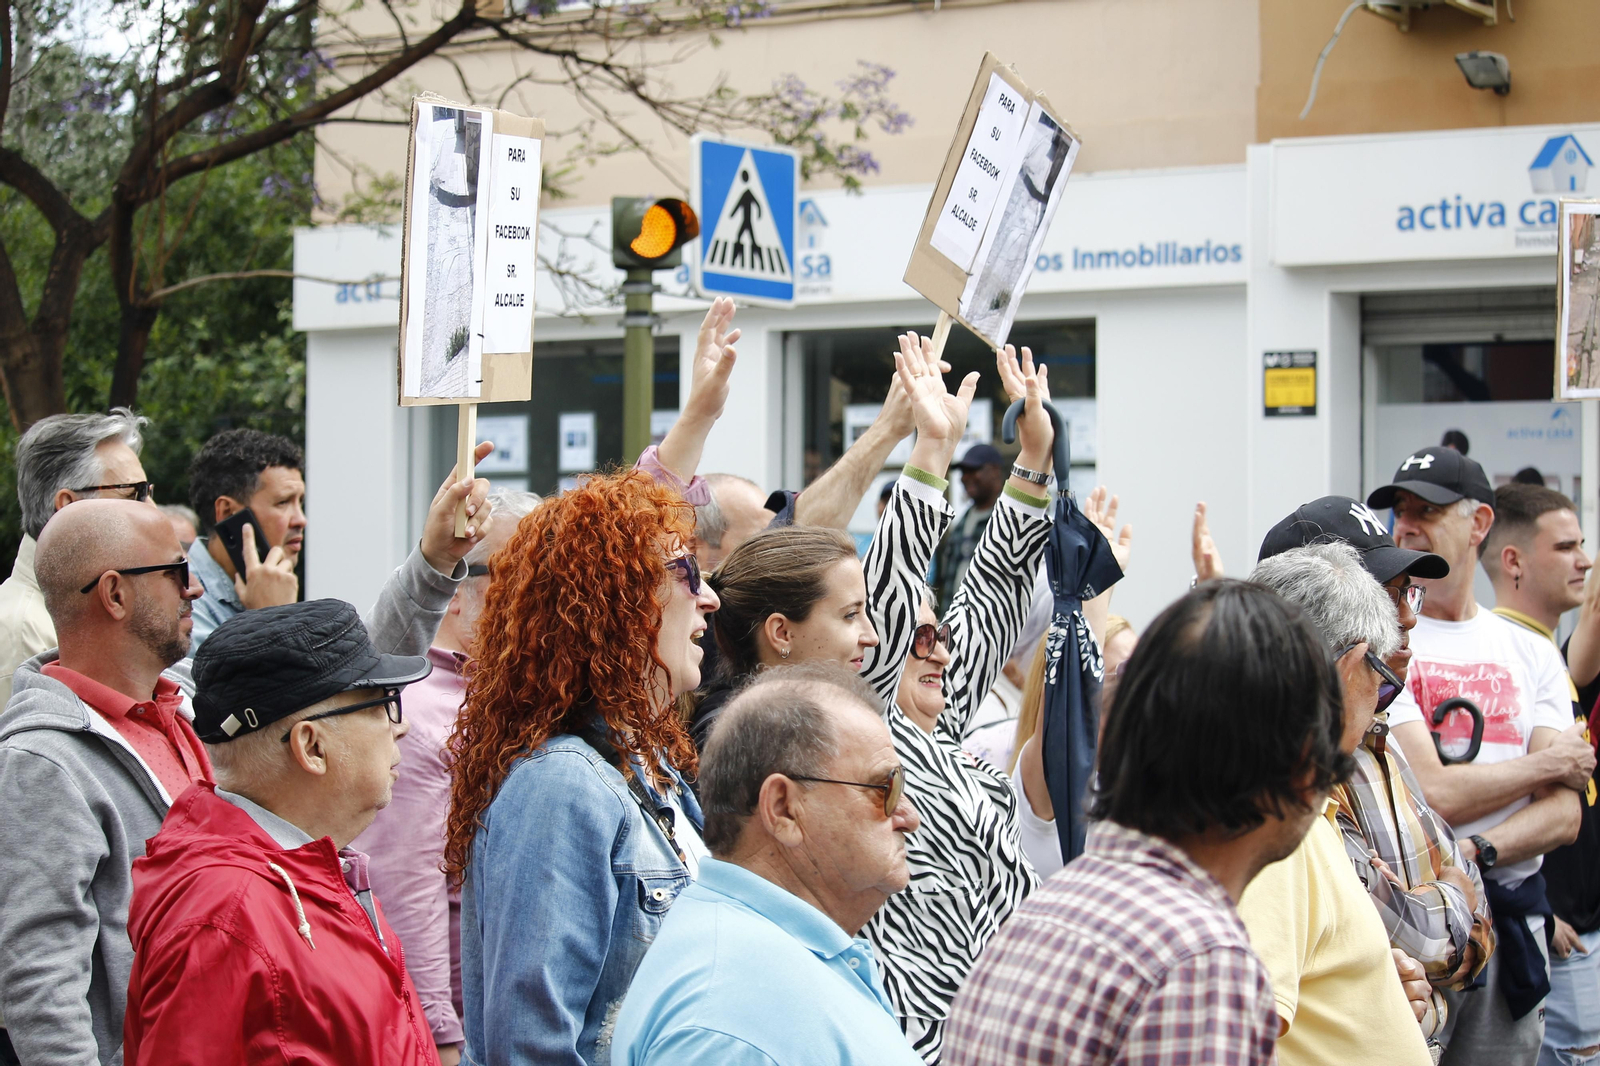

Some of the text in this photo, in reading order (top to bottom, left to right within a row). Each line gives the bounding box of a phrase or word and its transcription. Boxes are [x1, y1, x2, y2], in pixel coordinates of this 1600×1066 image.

[998, 93, 1015, 114] PARA
[990, 126, 1001, 141] SU
[508, 148, 526, 163] PARA
[970, 148, 1000, 181] FACEBOOK
[510, 187, 521, 201] SU
[968, 187, 978, 202] SR.
[951, 204, 977, 231] ALCALDE
[1396, 194, 1558, 231] activa ca
[495, 225, 531, 240] FACEBOOK
[1073, 239, 1242, 270] Inmobiliarios
[494, 293, 525, 307] ALCALDE
